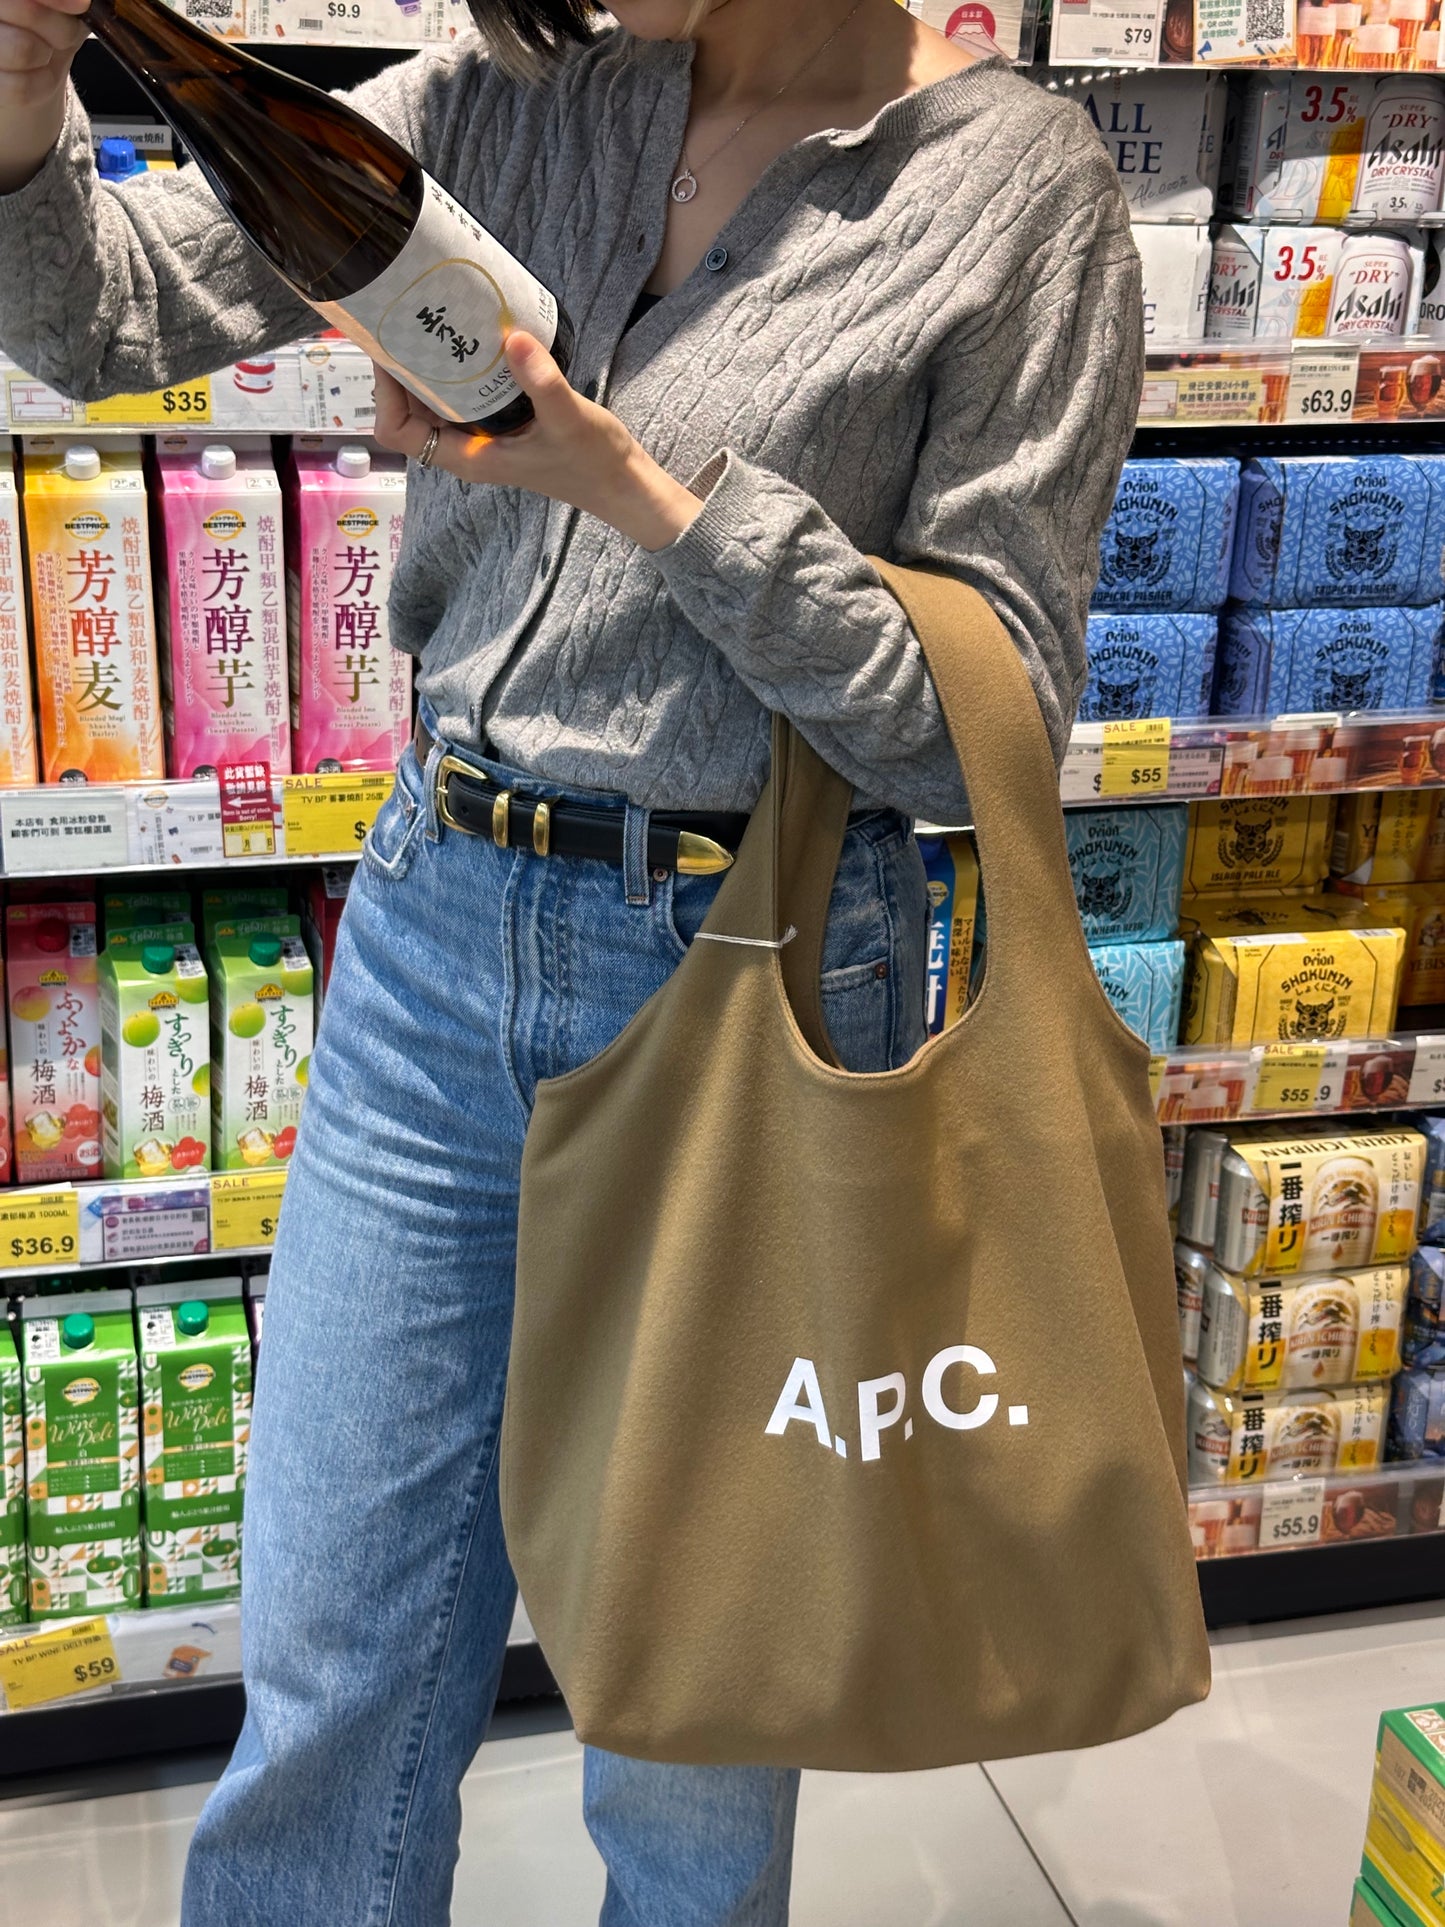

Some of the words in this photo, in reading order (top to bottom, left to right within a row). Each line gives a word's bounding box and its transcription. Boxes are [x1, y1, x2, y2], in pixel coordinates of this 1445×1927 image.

[328, 2, 361, 19] $9.9
[961, 10, 983, 19] 日本製
[1124, 28, 1152, 45] $79
[1368, 130, 1444, 170] Asahi
[1364, 260, 1389, 268] SUPER
[1334, 286, 1404, 323] Asahi
[162, 390, 207, 414] $35
[1301, 389, 1351, 415] $63.9
[1111, 497, 1179, 521] HOKUNIN
[1328, 490, 1406, 517] SHOKUNIN
[202, 521, 247, 529] BESTPRICE
[336, 519, 379, 527] BESTPRICE
[66, 548, 123, 713] 芳醇麦
[202, 547, 255, 709] 芳醇芋
[333, 545, 383, 703] 芳醇芋
[1315, 635, 1390, 663] SHOKUNIN
[1104, 722, 1137, 734] SALE
[286, 777, 323, 790] SALE
[1130, 768, 1162, 785] $55
[301, 795, 314, 804] TV
[315, 794, 328, 803] BP
[11, 827, 60, 838] 顧客們可到
[15, 817, 44, 827] 本店有
[49, 814, 107, 826] 食用冰粒發售
[1210, 872, 1242, 882] ISLAND
[1243, 870, 1264, 881] PALE
[1265, 869, 1281, 879] ALE
[1091, 924, 1121, 935] WHEAT
[1122, 921, 1144, 932] BEER
[1303, 953, 1335, 967] Orion
[1280, 968, 1353, 994] SHOKUNIN
[1295, 982, 1339, 997] しょくにん
[37, 1023, 48, 1056] 味わいの
[56, 989, 88, 1071] ふくよかな
[1264, 1044, 1295, 1055] SALE
[31, 1058, 58, 1105] 梅酒
[244, 1074, 270, 1122] 梅酒
[1279, 1088, 1310, 1102] $55
[139, 1083, 166, 1133] 梅酒
[213, 1177, 250, 1190] SALE
[39, 1208, 70, 1218] 1000ML
[1278, 1161, 1304, 1253] 一番搾り
[1311, 1214, 1334, 1229] KIRIN
[11, 1235, 75, 1258] $36.9
[1321, 1230, 1360, 1242] 一番搾り
[1257, 1280, 1284, 1370] 一番搾り
[1302, 1347, 1341, 1360] 一番搾り
[764, 1344, 1029, 1462] A.P.C.
[165, 1402, 213, 1430] Wine
[193, 1406, 230, 1434] Deli
[49, 1416, 98, 1444] Wine
[77, 1420, 116, 1448] Deli
[1240, 1394, 1266, 1479] 一番搾り
[1273, 1514, 1319, 1539] $55.9
[74, 1656, 115, 1683] $59
